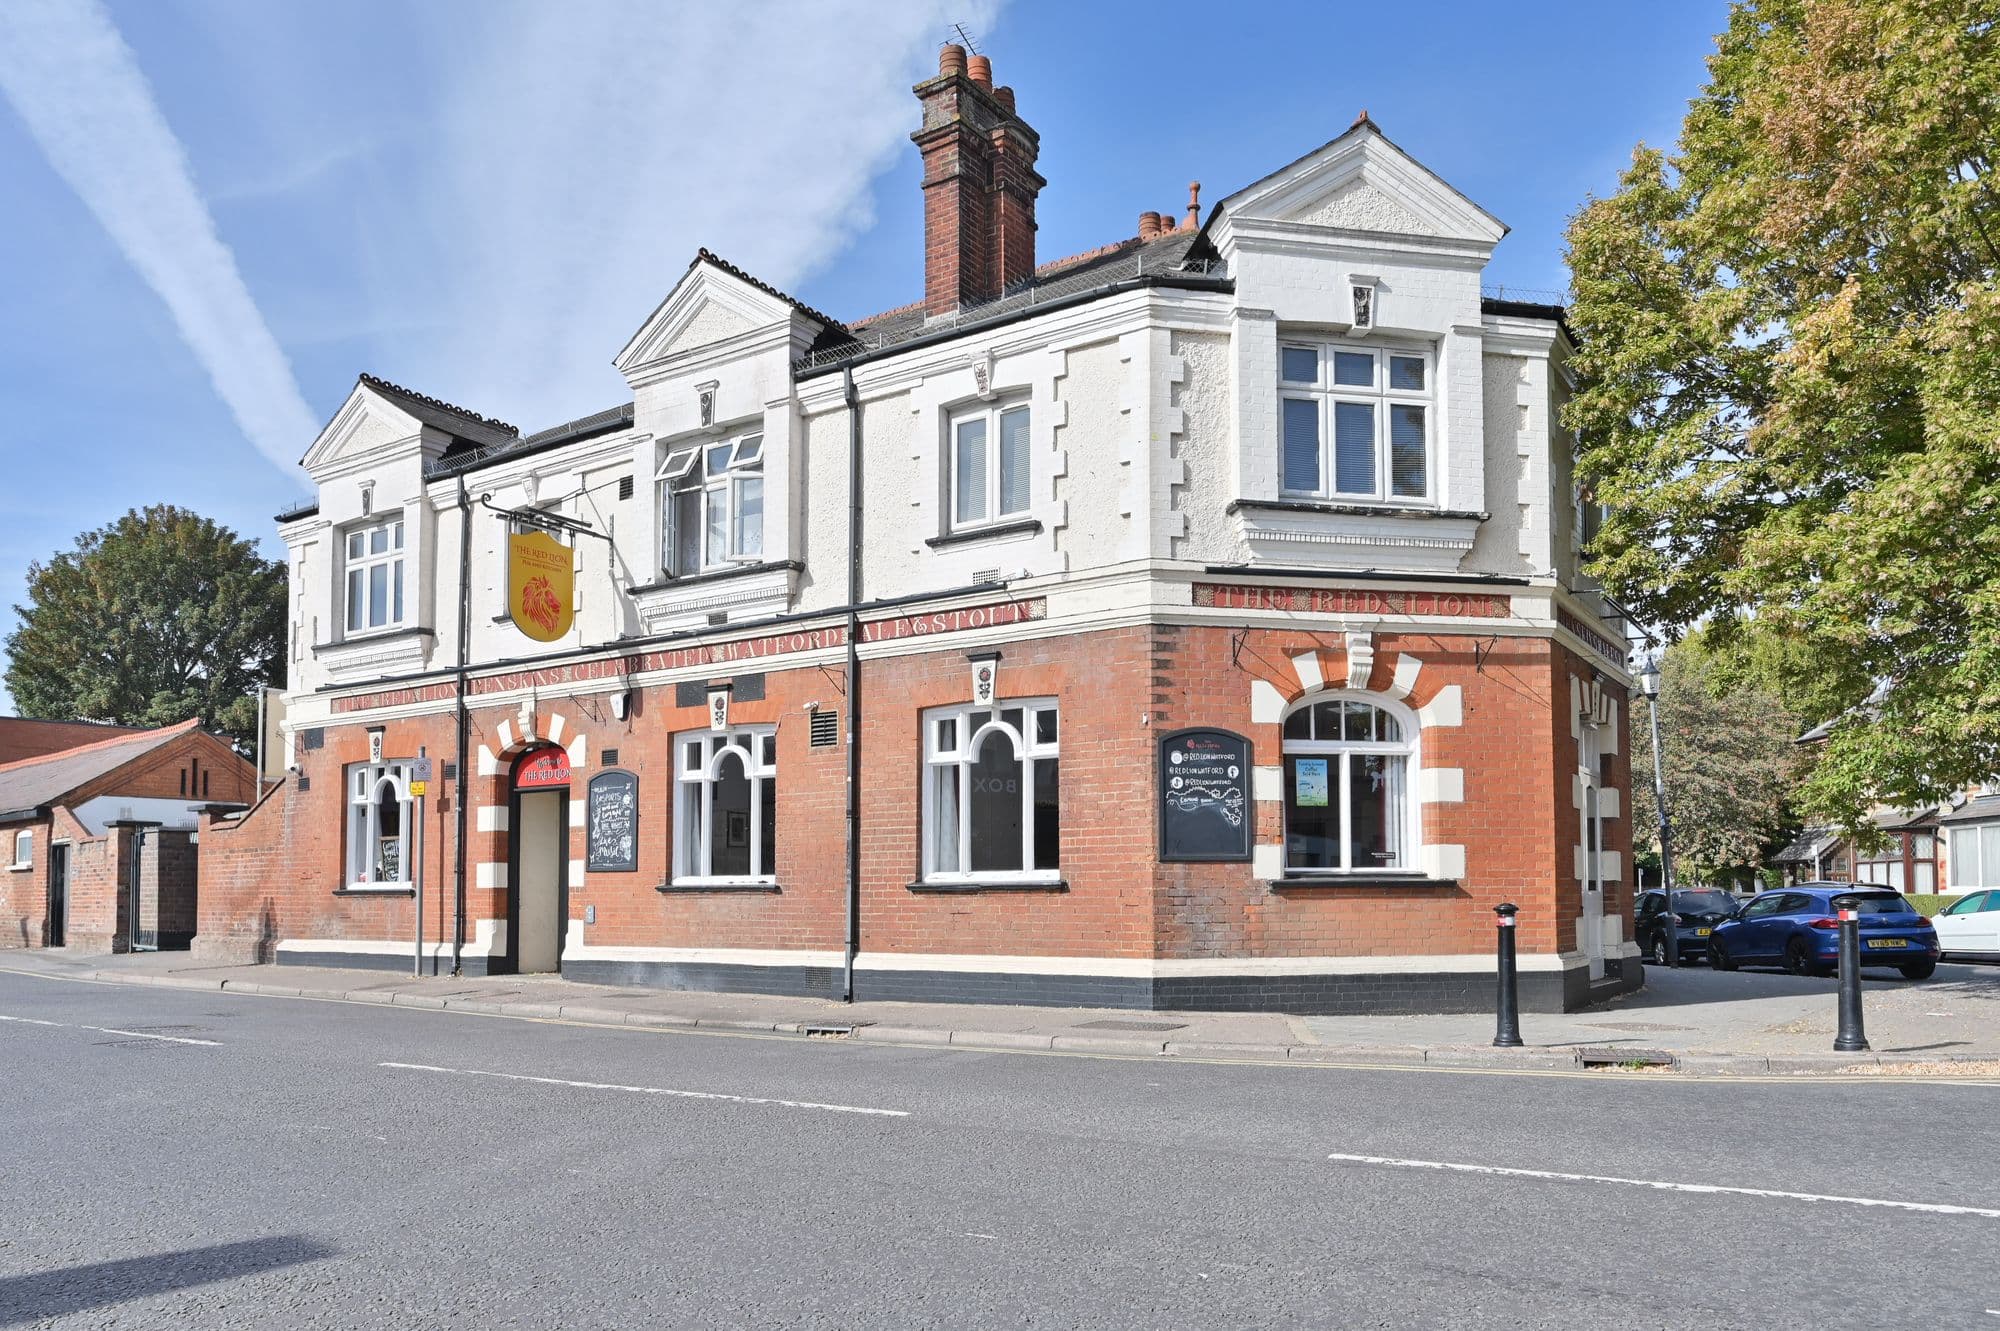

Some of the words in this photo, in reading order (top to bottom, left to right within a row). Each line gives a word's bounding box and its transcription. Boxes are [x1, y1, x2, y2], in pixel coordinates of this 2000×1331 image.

[1217, 586, 1288, 610] THE
[1315, 590, 1383, 614] RED
[1410, 593, 1495, 616] LION
[380, 689, 412, 706] RED
[422, 684, 458, 702] LION
[574, 648, 711, 682] CELEBRATED
[721, 628, 838, 662] WATFORD
[525, 770, 538, 782] THE
[539, 769, 554, 780] RED
[554, 768, 571, 781] LION
